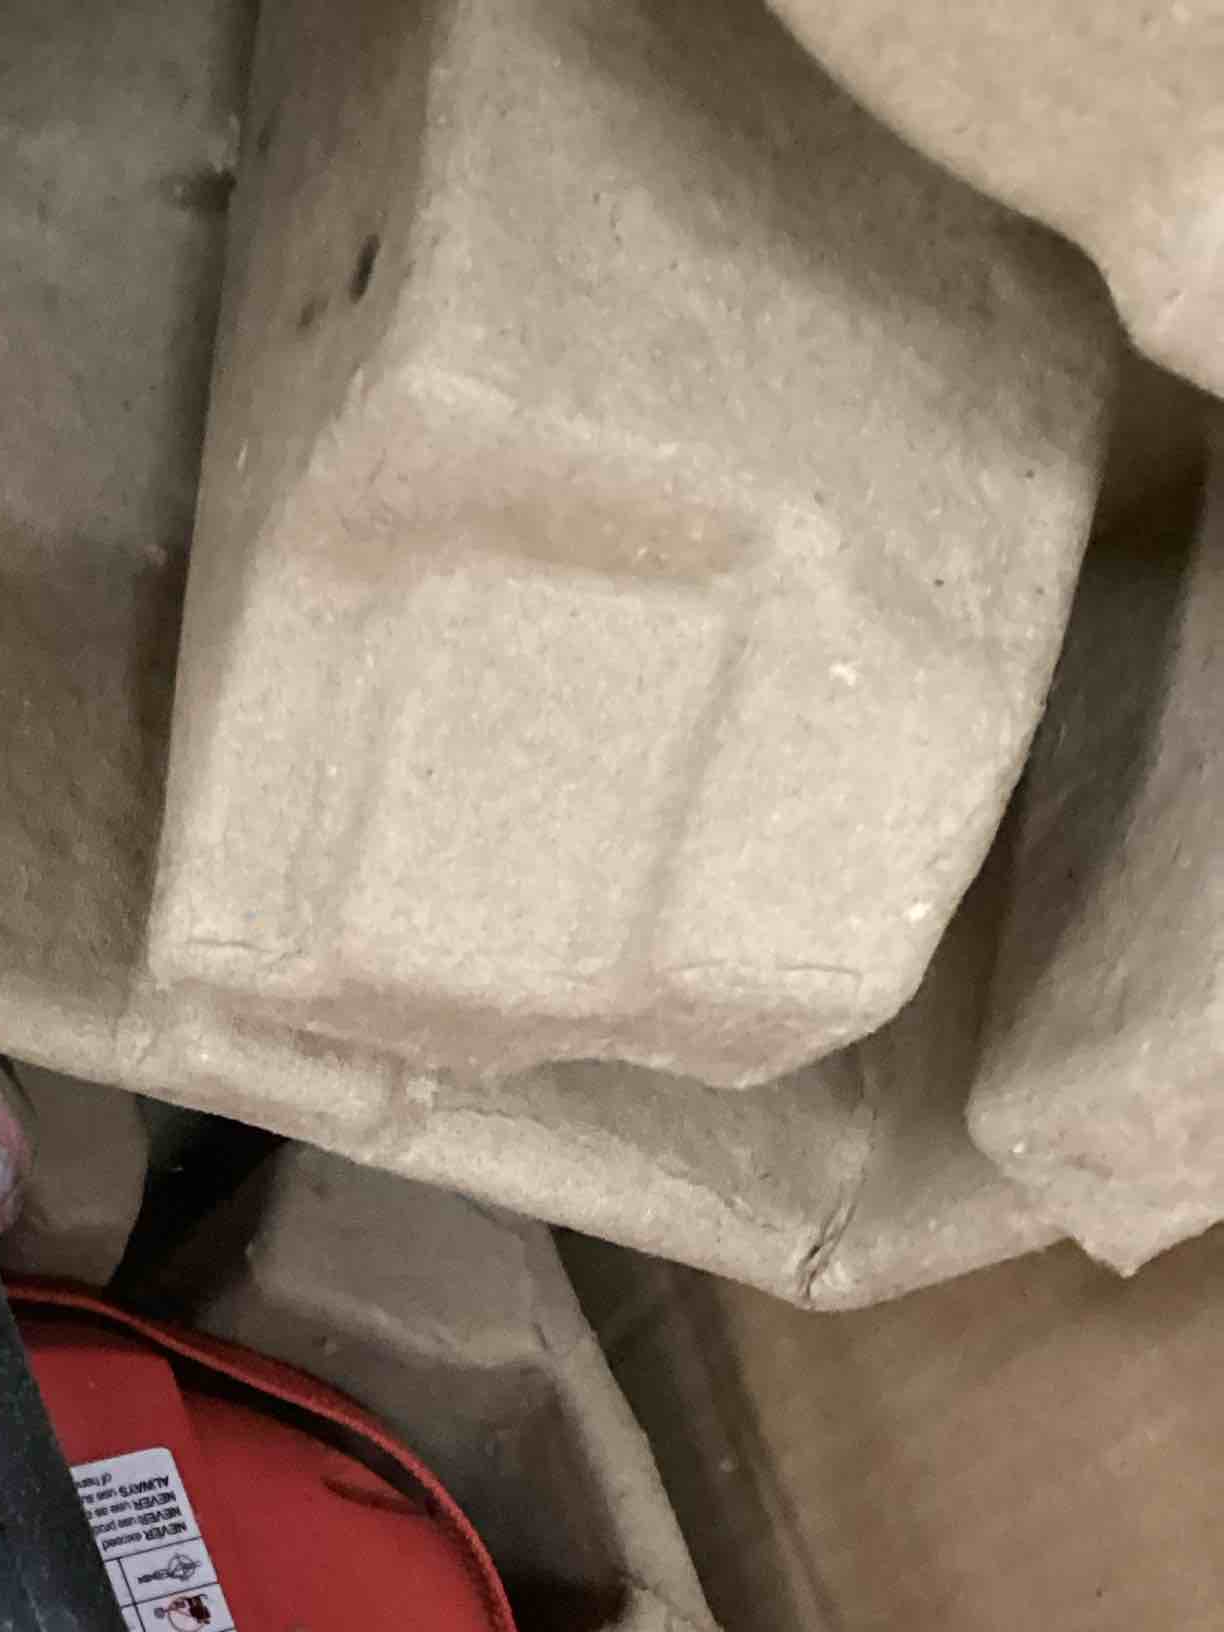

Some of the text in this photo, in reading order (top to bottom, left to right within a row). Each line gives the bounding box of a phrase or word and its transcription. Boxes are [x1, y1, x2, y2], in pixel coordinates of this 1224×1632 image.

[117, 1475, 169, 1498] ALWAYS
[132, 1491, 176, 1510] NEVER
[137, 1506, 181, 1525] NEVER
[142, 1521, 187, 1541] NEVER
